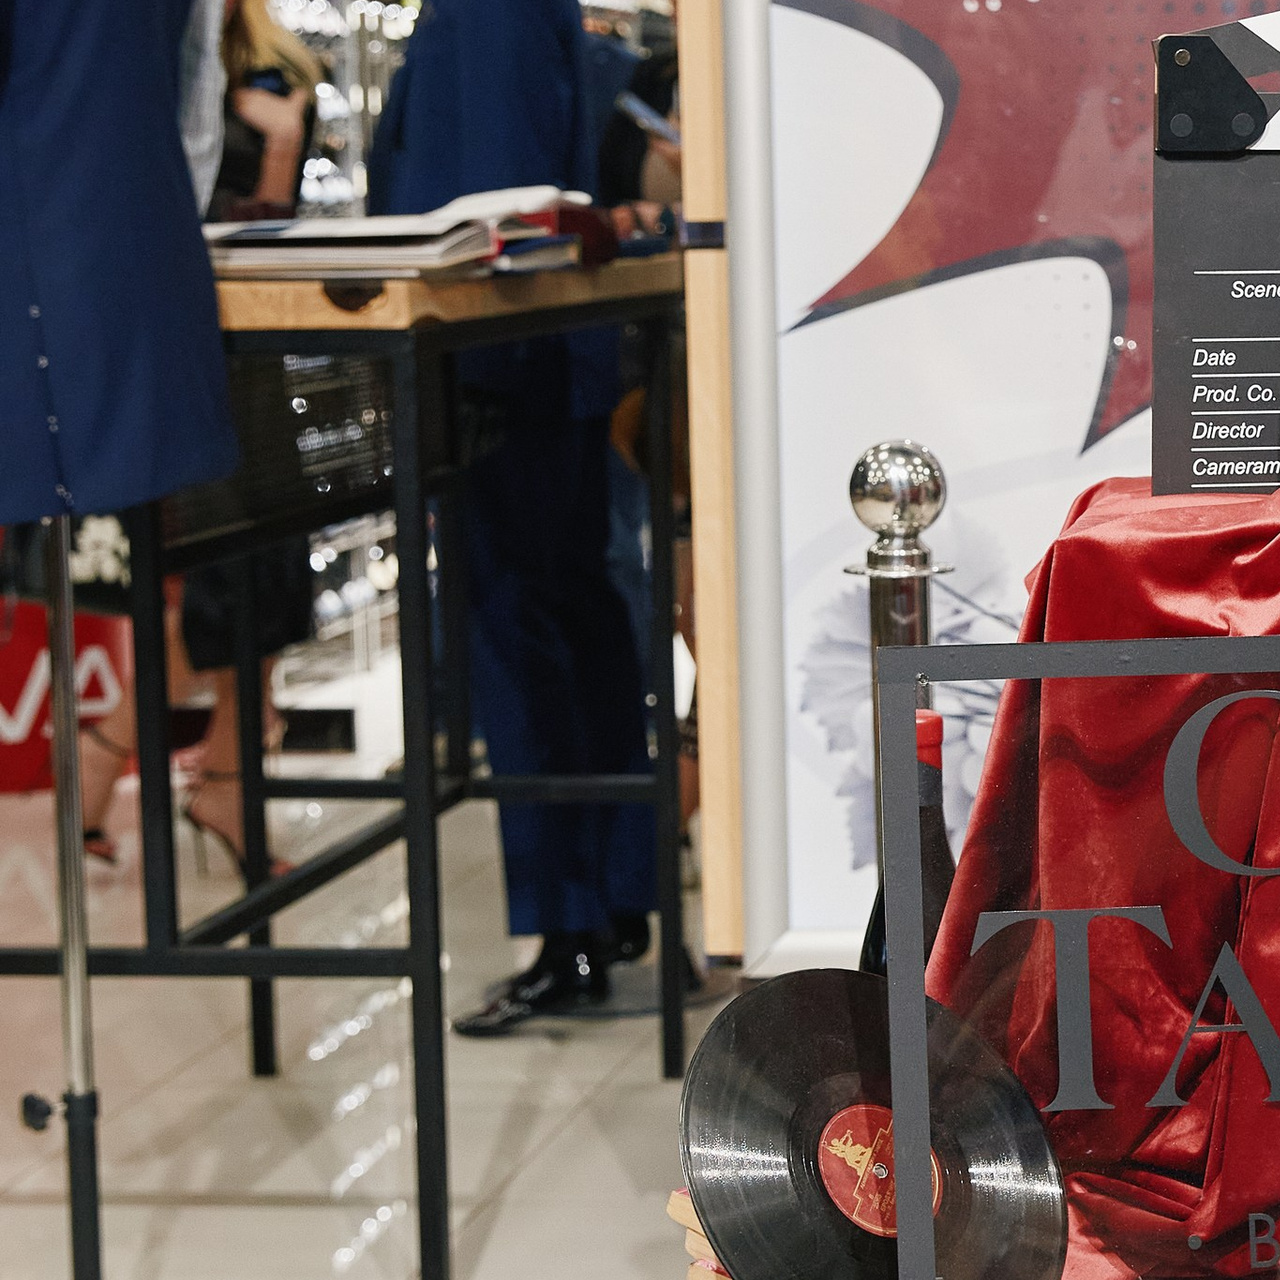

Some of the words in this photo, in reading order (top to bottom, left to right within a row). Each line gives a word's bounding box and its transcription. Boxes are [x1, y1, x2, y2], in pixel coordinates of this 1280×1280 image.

[1192, 348, 1236, 366] Date
[1192, 384, 1240, 403] Prod.
[1247, 383, 1277, 402] Co.
[1192, 421, 1265, 440] Director
